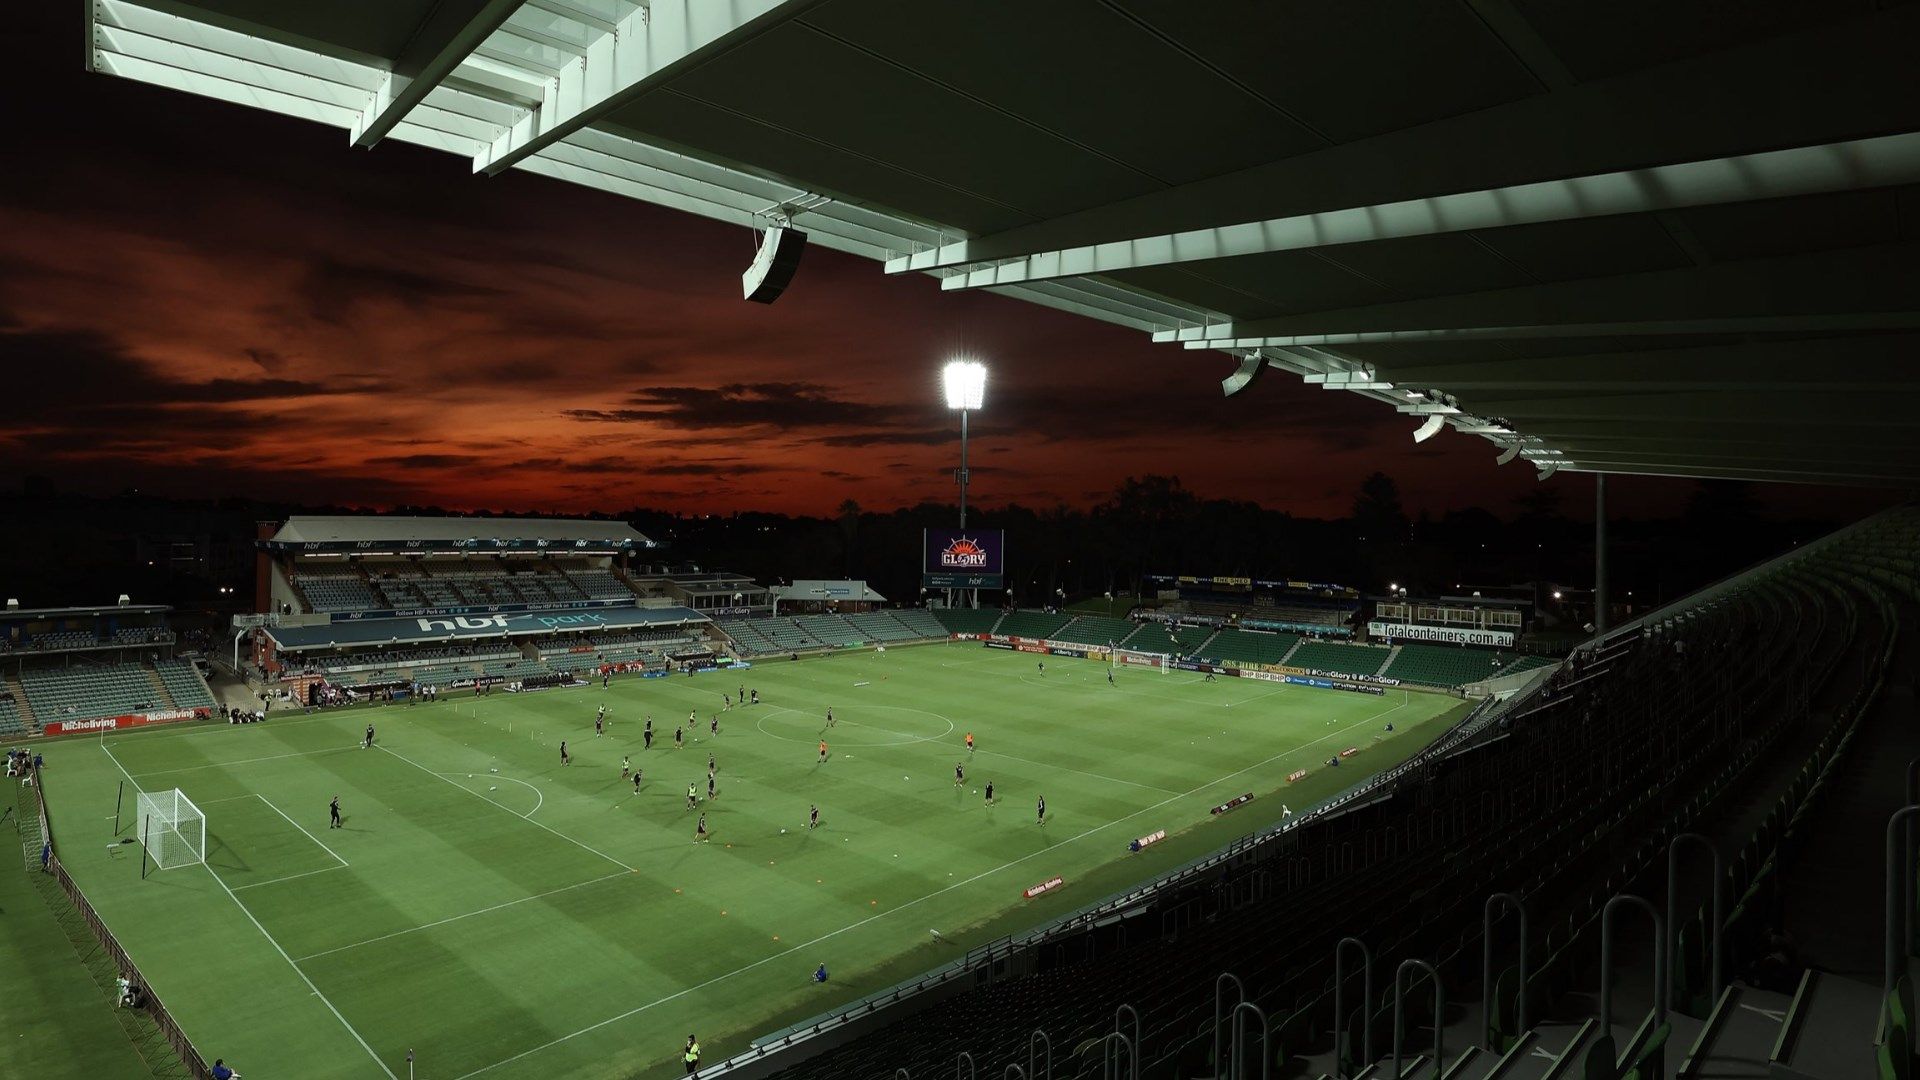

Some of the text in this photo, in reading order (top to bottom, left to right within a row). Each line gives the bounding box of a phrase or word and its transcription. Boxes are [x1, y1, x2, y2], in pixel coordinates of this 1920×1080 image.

[943, 553, 986, 565] GLORY
[417, 613, 608, 631] hbf park
[1384, 623, 1513, 646] Totalcontainers.com.au
[1311, 669, 1351, 680] #OneGlory
[1358, 674, 1400, 686] #OneGlory
[146, 709, 195, 721] Nicheliving
[61, 718, 116, 731] Nicheliving
